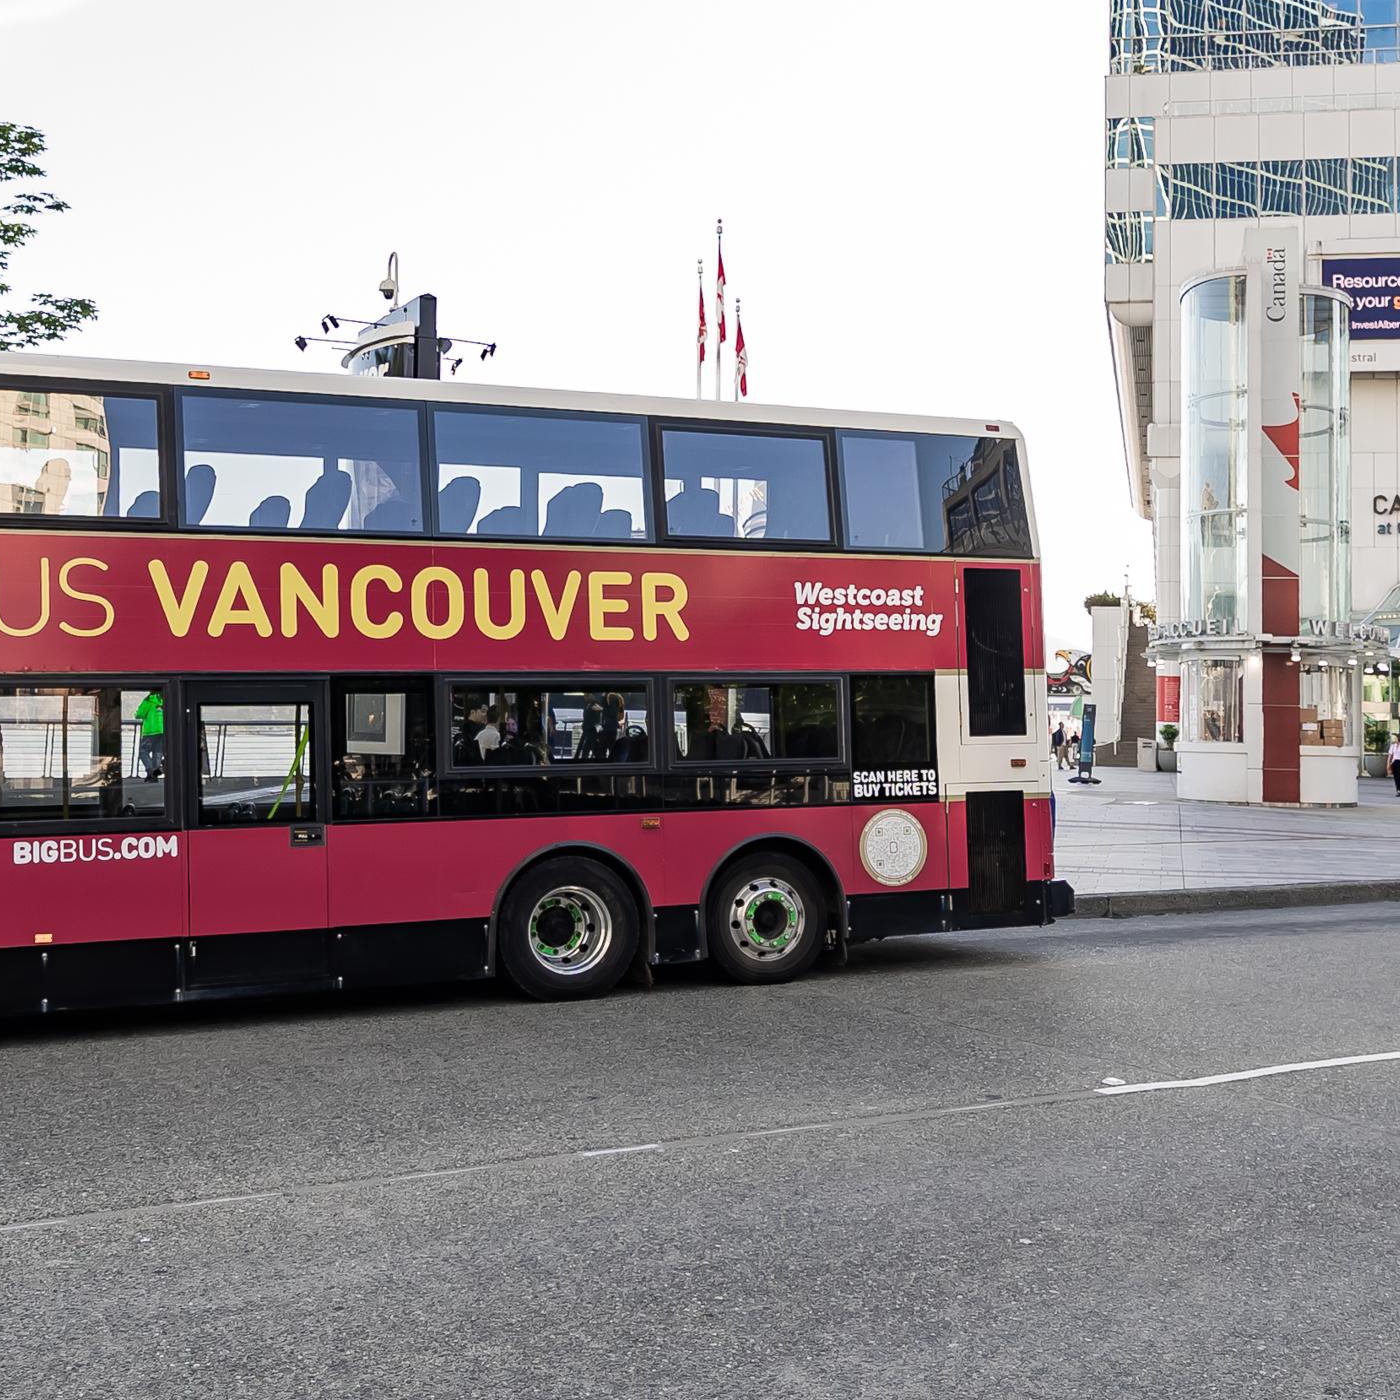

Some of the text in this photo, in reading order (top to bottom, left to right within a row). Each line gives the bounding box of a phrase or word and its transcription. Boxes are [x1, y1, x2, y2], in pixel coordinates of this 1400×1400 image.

[1266, 247, 1286, 322] Canada
[1356, 295, 1391, 310] your
[1350, 353, 1377, 363] stral
[1377, 523, 1392, 535] at
[147, 559, 690, 642] VANCOUVER
[794, 581, 924, 606] Westcoast
[796, 607, 943, 636] Sightseeing
[853, 769, 936, 783] SCAN HERE TO
[854, 782, 937, 797] BUY TICKETS
[13, 835, 178, 864] BIGBUS.COM
